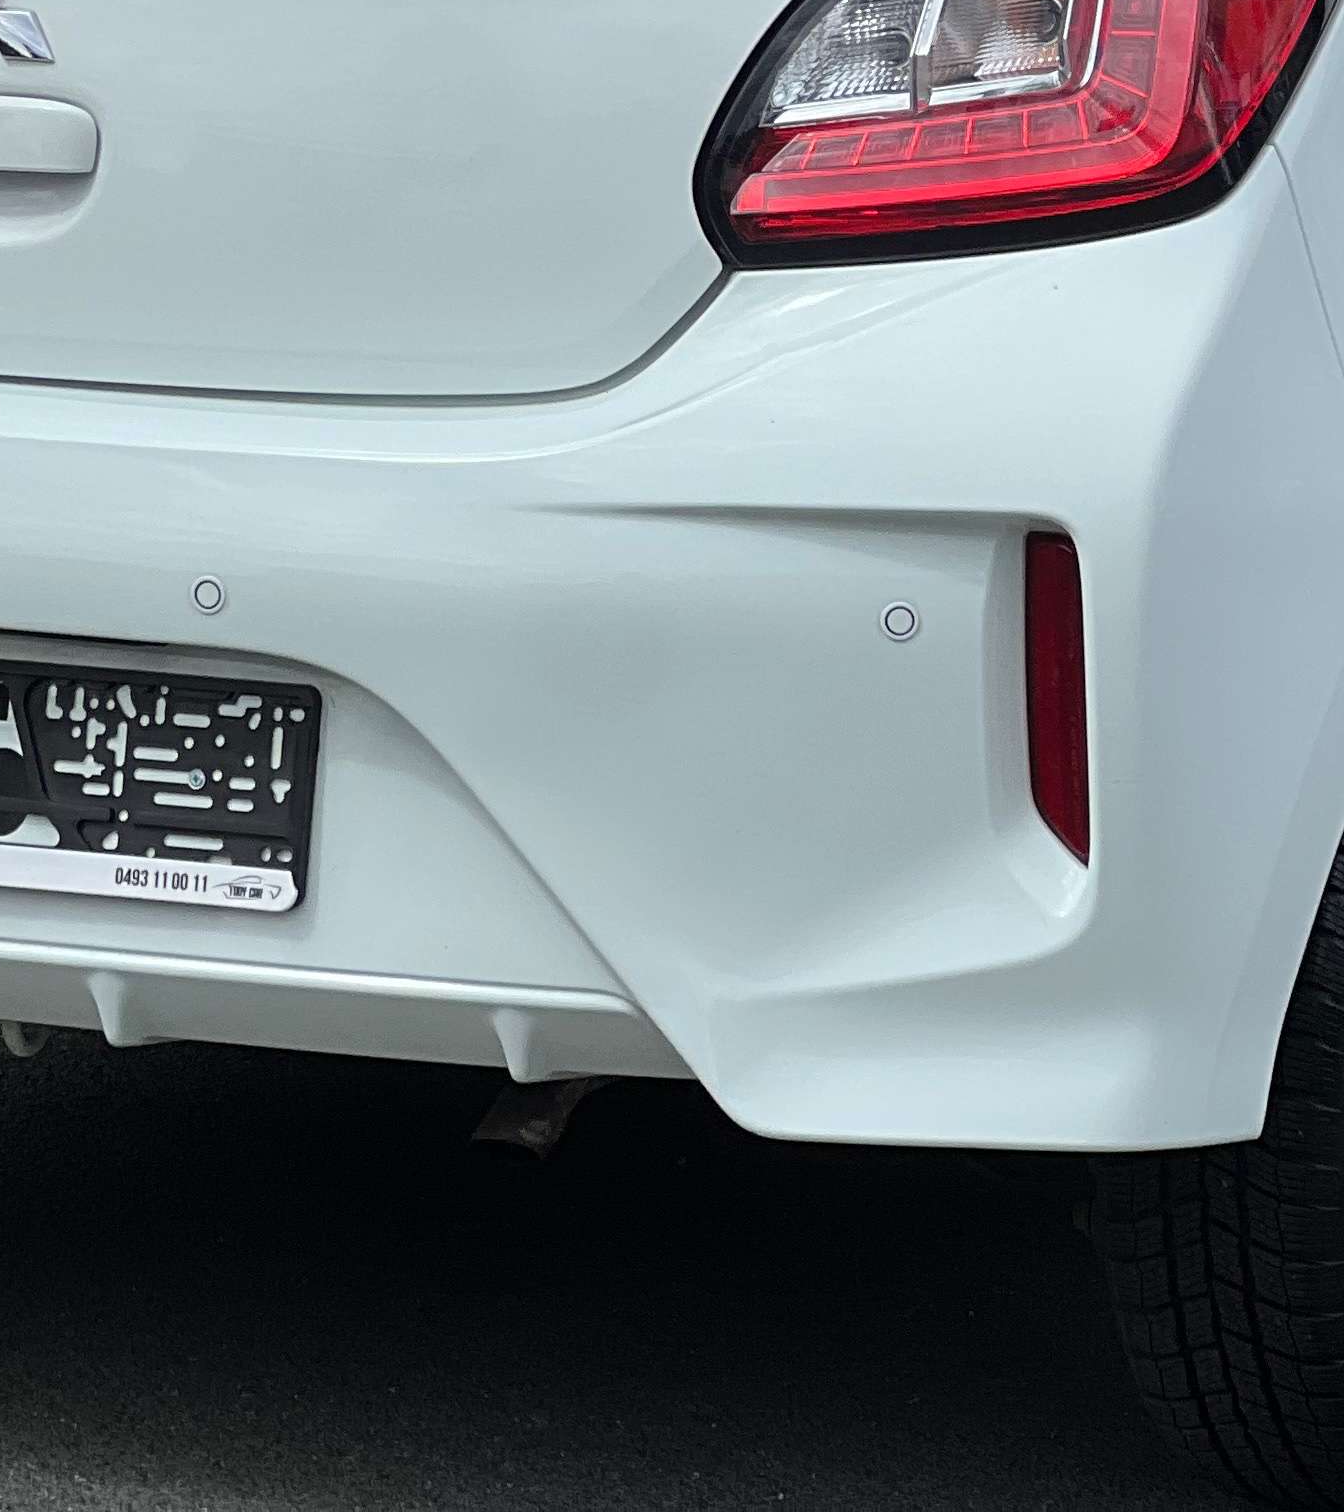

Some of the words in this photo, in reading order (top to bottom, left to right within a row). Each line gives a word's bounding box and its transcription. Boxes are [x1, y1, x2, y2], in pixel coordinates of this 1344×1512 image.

[114, 867, 150, 888] 0493
[154, 870, 168, 889] 11
[171, 872, 189, 891] 00
[193, 874, 208, 893] 11
